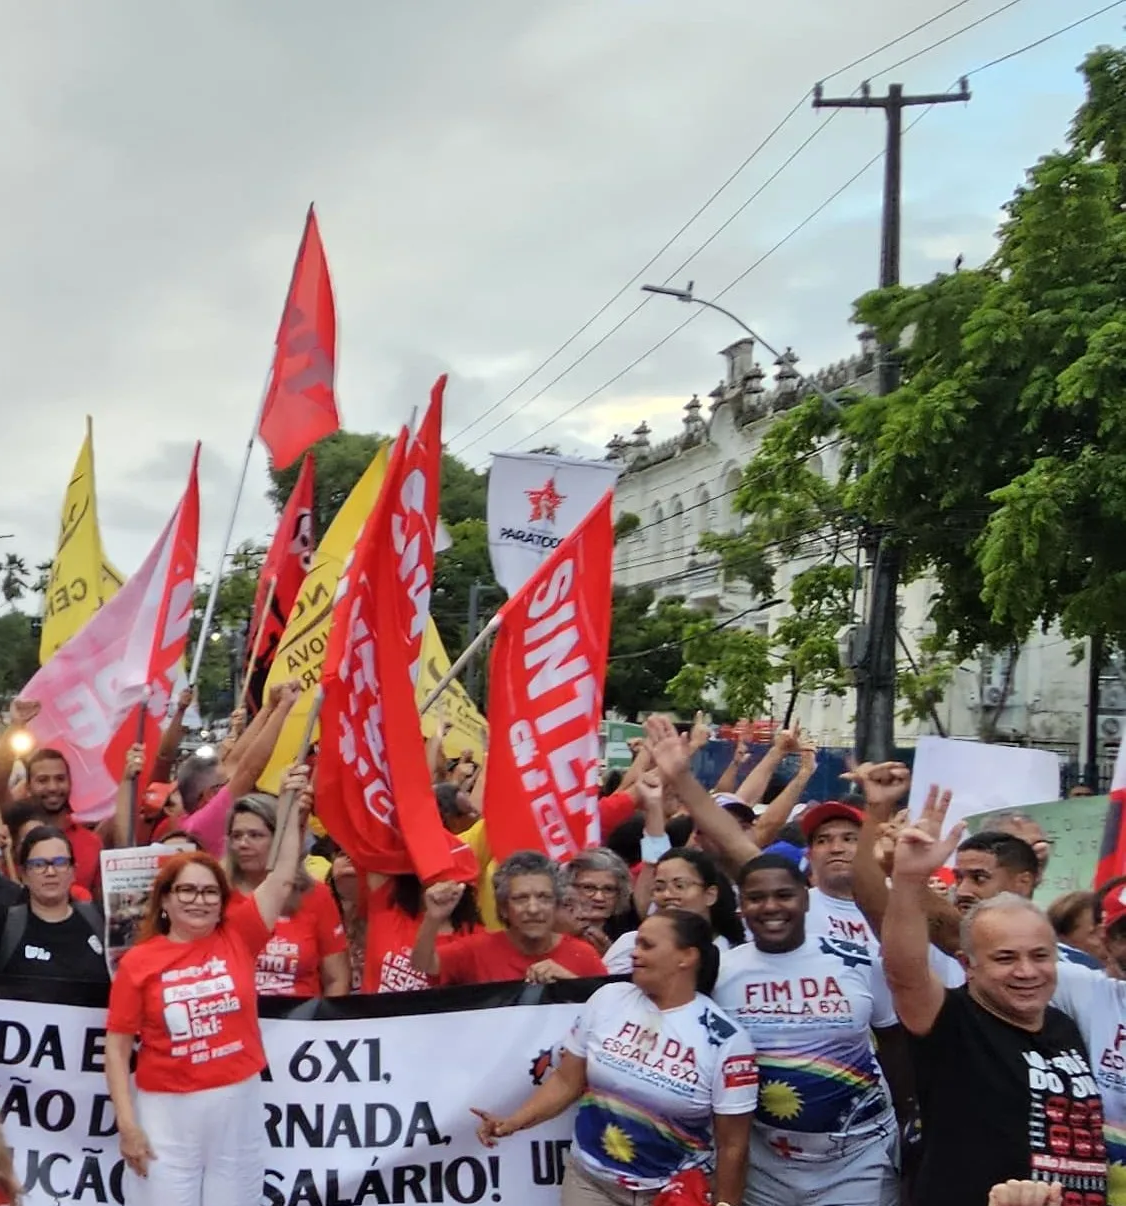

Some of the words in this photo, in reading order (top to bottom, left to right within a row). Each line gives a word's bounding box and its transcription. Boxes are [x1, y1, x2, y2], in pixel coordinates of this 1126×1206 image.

[187, 992, 241, 1019] Escala
[745, 979, 793, 1005] FIM
[799, 975, 844, 999] DA
[818, 999, 852, 1014] 6X1
[288, 1037, 392, 1085] 6X1,
[601, 1036, 665, 1073] ESCALA
[617, 1020, 660, 1052] FIM
[662, 1036, 697, 1069] DA
